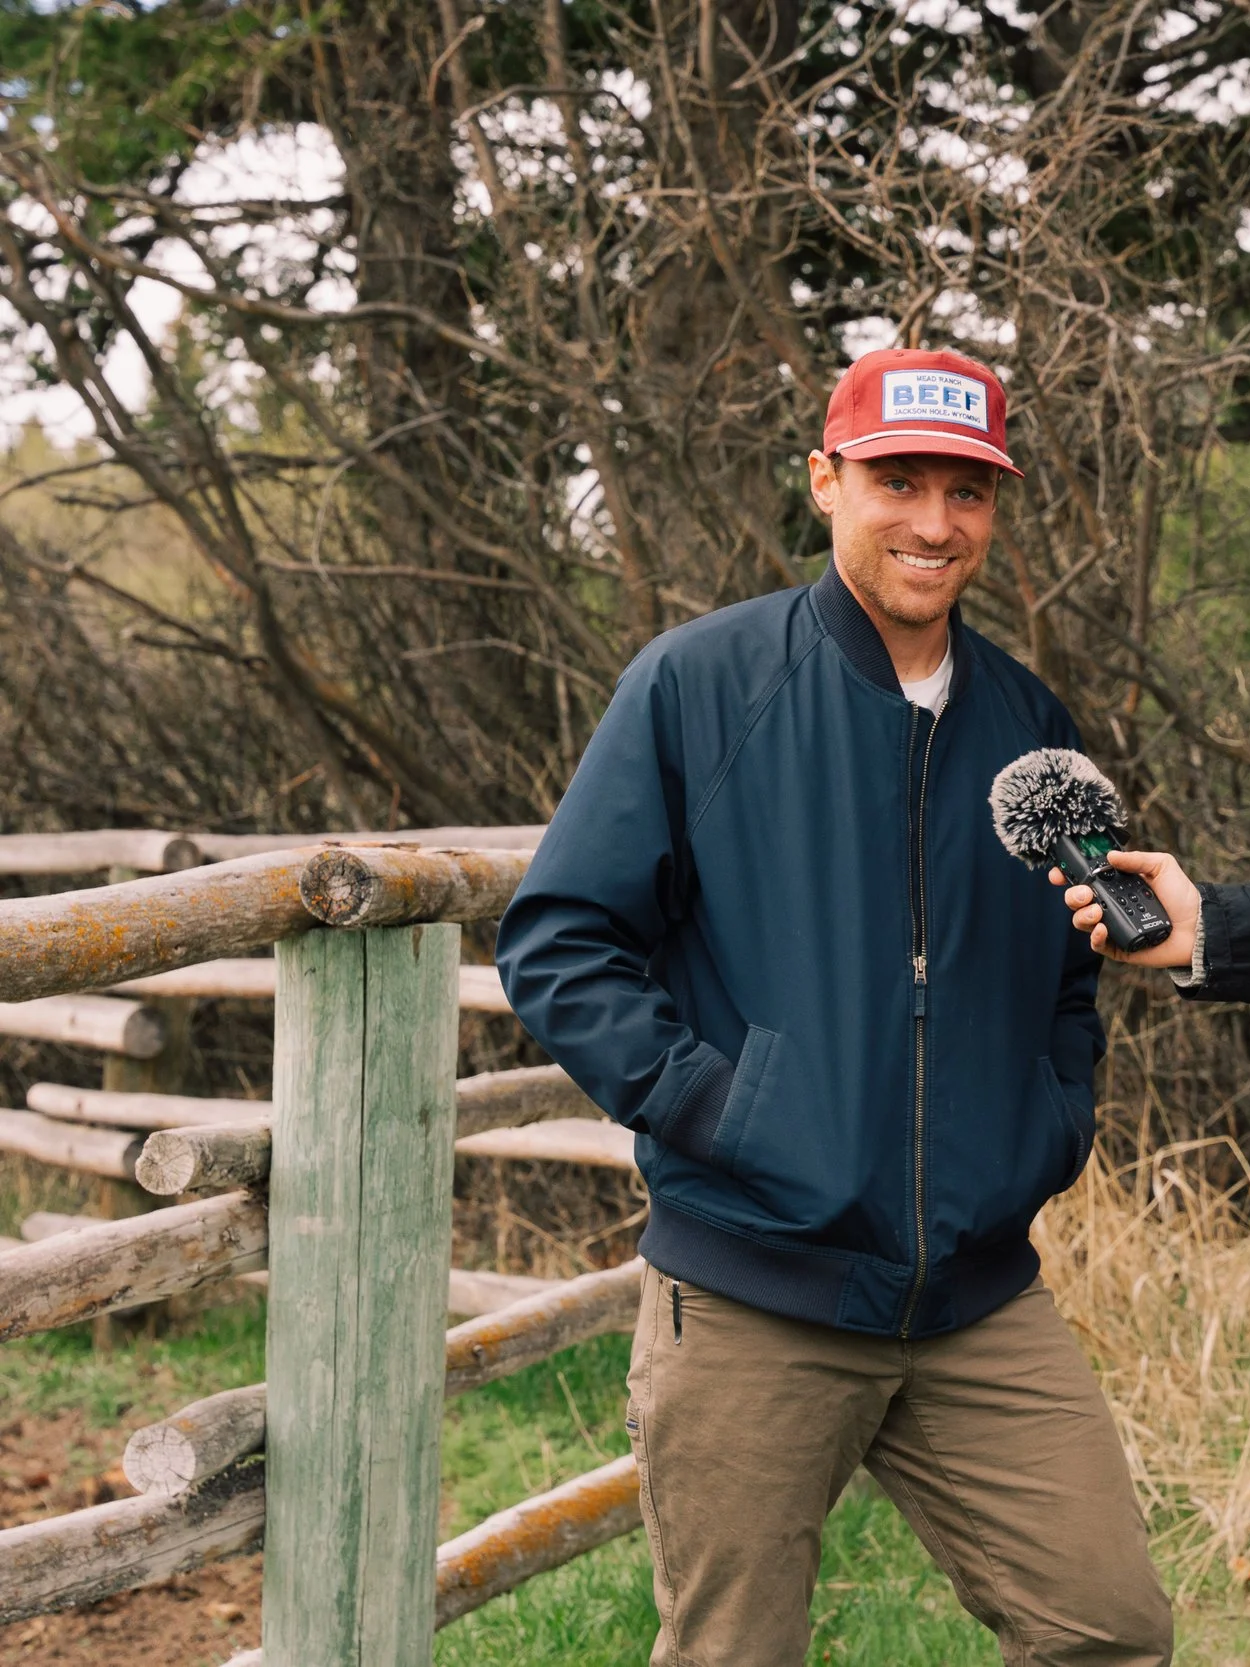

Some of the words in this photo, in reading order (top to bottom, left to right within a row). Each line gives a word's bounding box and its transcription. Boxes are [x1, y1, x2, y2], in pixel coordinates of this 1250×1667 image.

[939, 376, 962, 386] RANCH
[893, 384, 980, 411] BEEF
[952, 411, 980, 423] WYOMING
